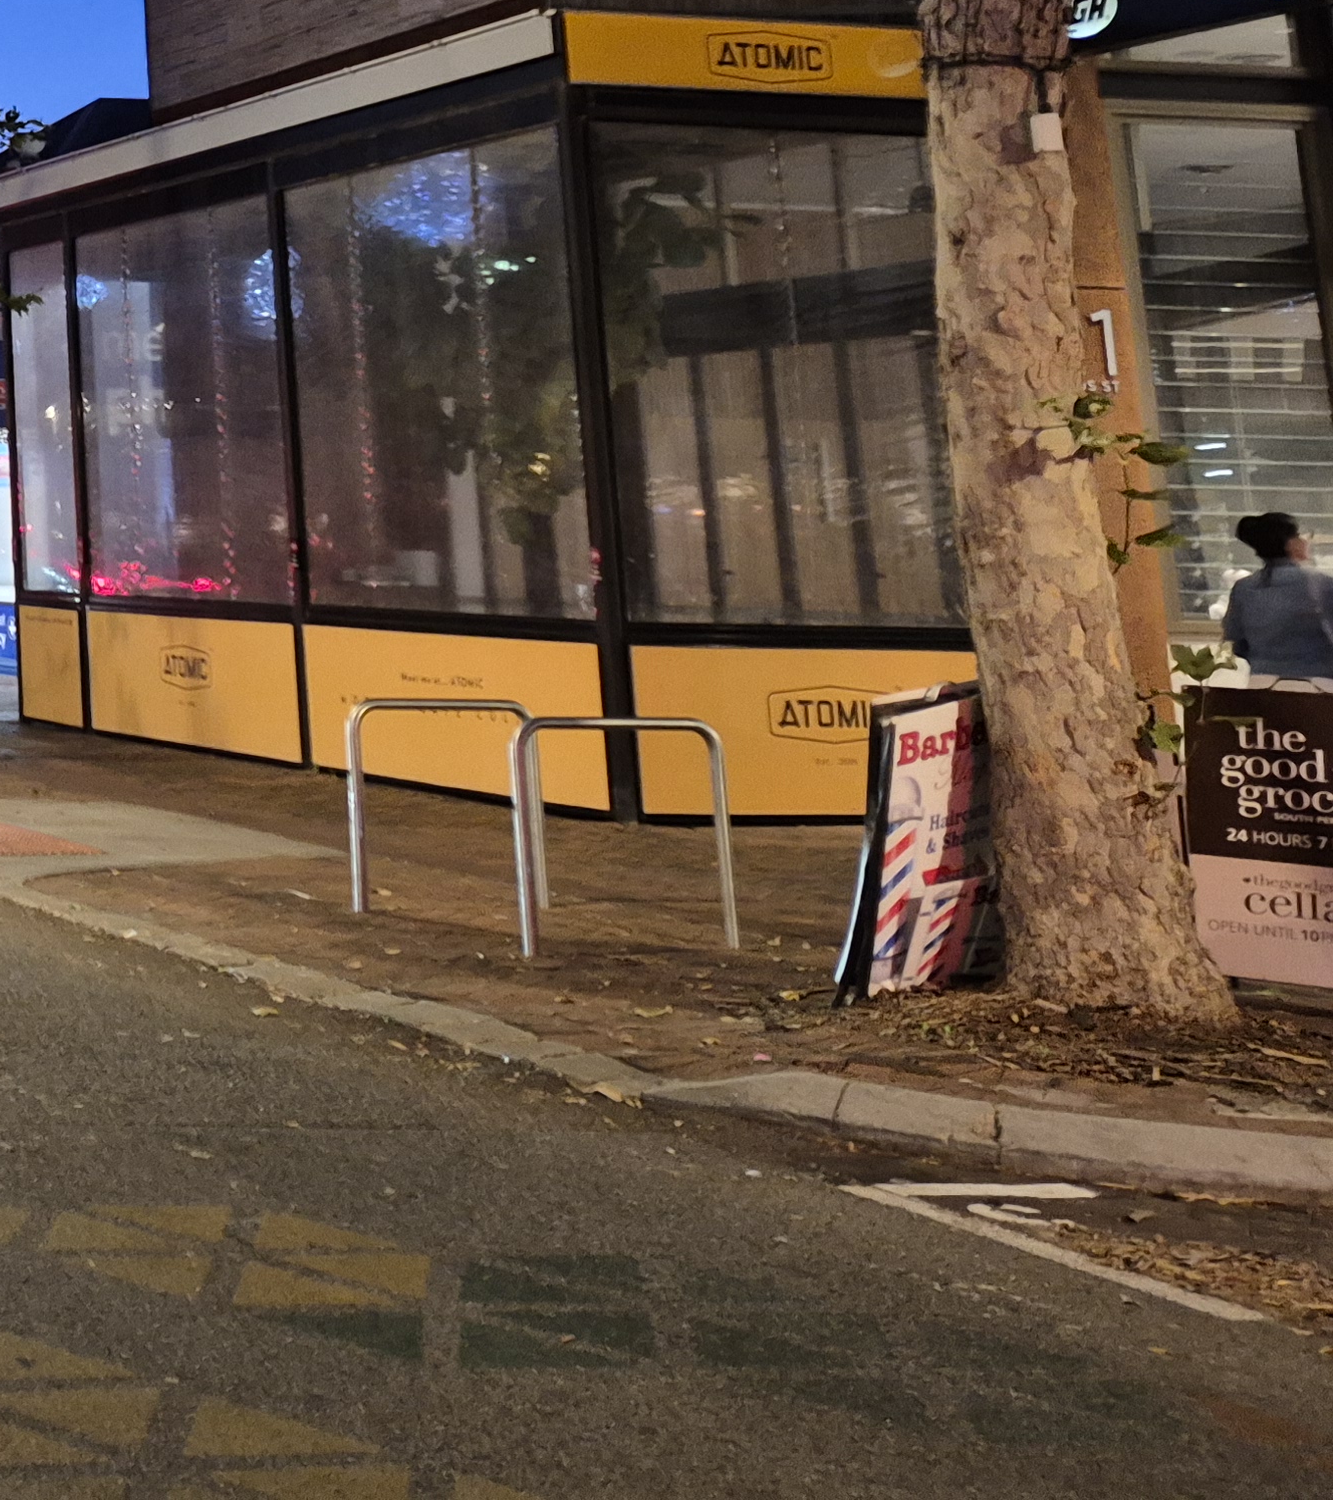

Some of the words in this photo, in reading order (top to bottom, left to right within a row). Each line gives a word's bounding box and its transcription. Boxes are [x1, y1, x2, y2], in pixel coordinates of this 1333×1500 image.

[717, 42, 824, 72] ATOMIC
[164, 653, 209, 681] ATOMIC
[777, 699, 869, 729] ATOMI
[896, 716, 988, 768] Barbe
[1235, 717, 1307, 753] the
[1220, 749, 1330, 788] good
[1238, 784, 1333, 819] groc
[1226, 827, 1250, 843] 24
[1252, 830, 1312, 849] HOURS
[1317, 836, 1329, 850] 7
[1208, 919, 1249, 935] OPEN
[1254, 924, 1298, 941] UNTIL
